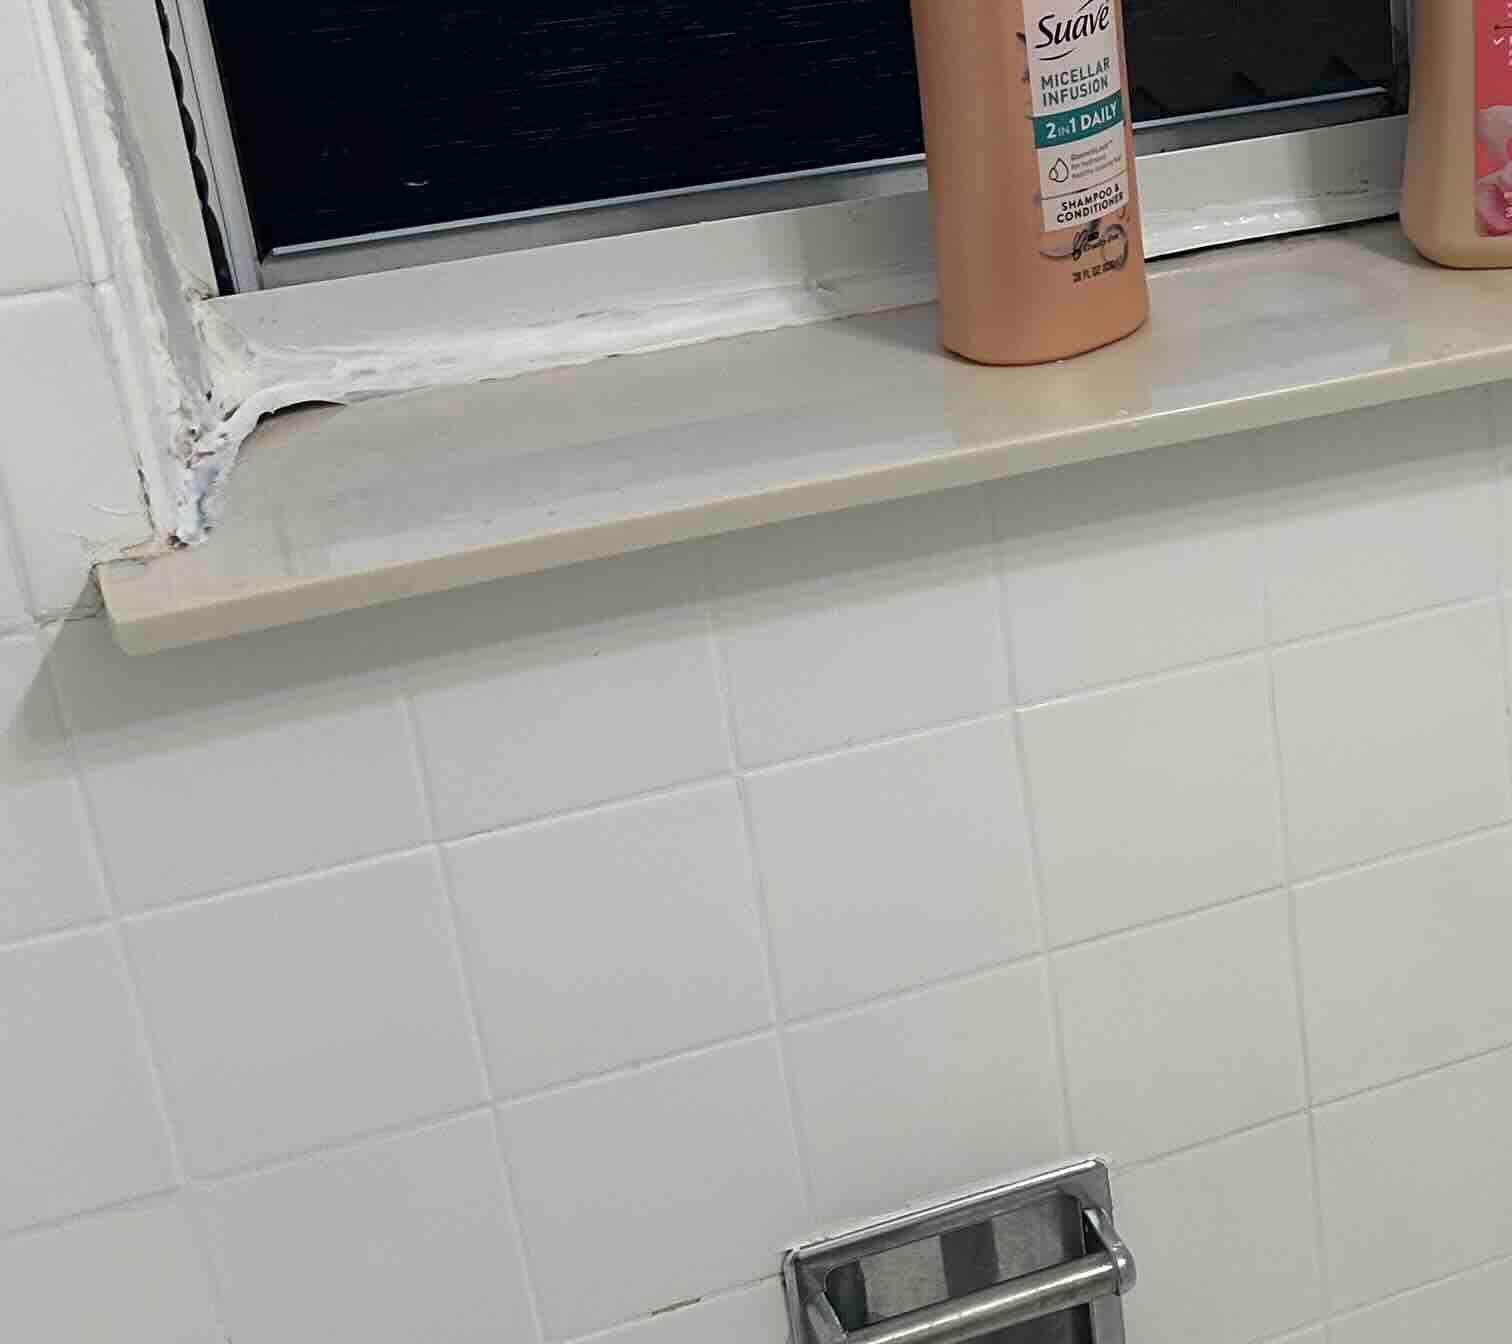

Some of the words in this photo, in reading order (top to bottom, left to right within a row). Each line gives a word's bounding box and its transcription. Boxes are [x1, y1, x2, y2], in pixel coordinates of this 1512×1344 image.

[1035, 2, 1110, 49] Suave
[1041, 57, 1111, 90] MICELLAR
[1042, 74, 1108, 107] INFUSION
[1080, 101, 1117, 130] DAILY
[1056, 192, 1124, 224] CONDITIONER
[1061, 187, 1112, 212] SHAMPOO
